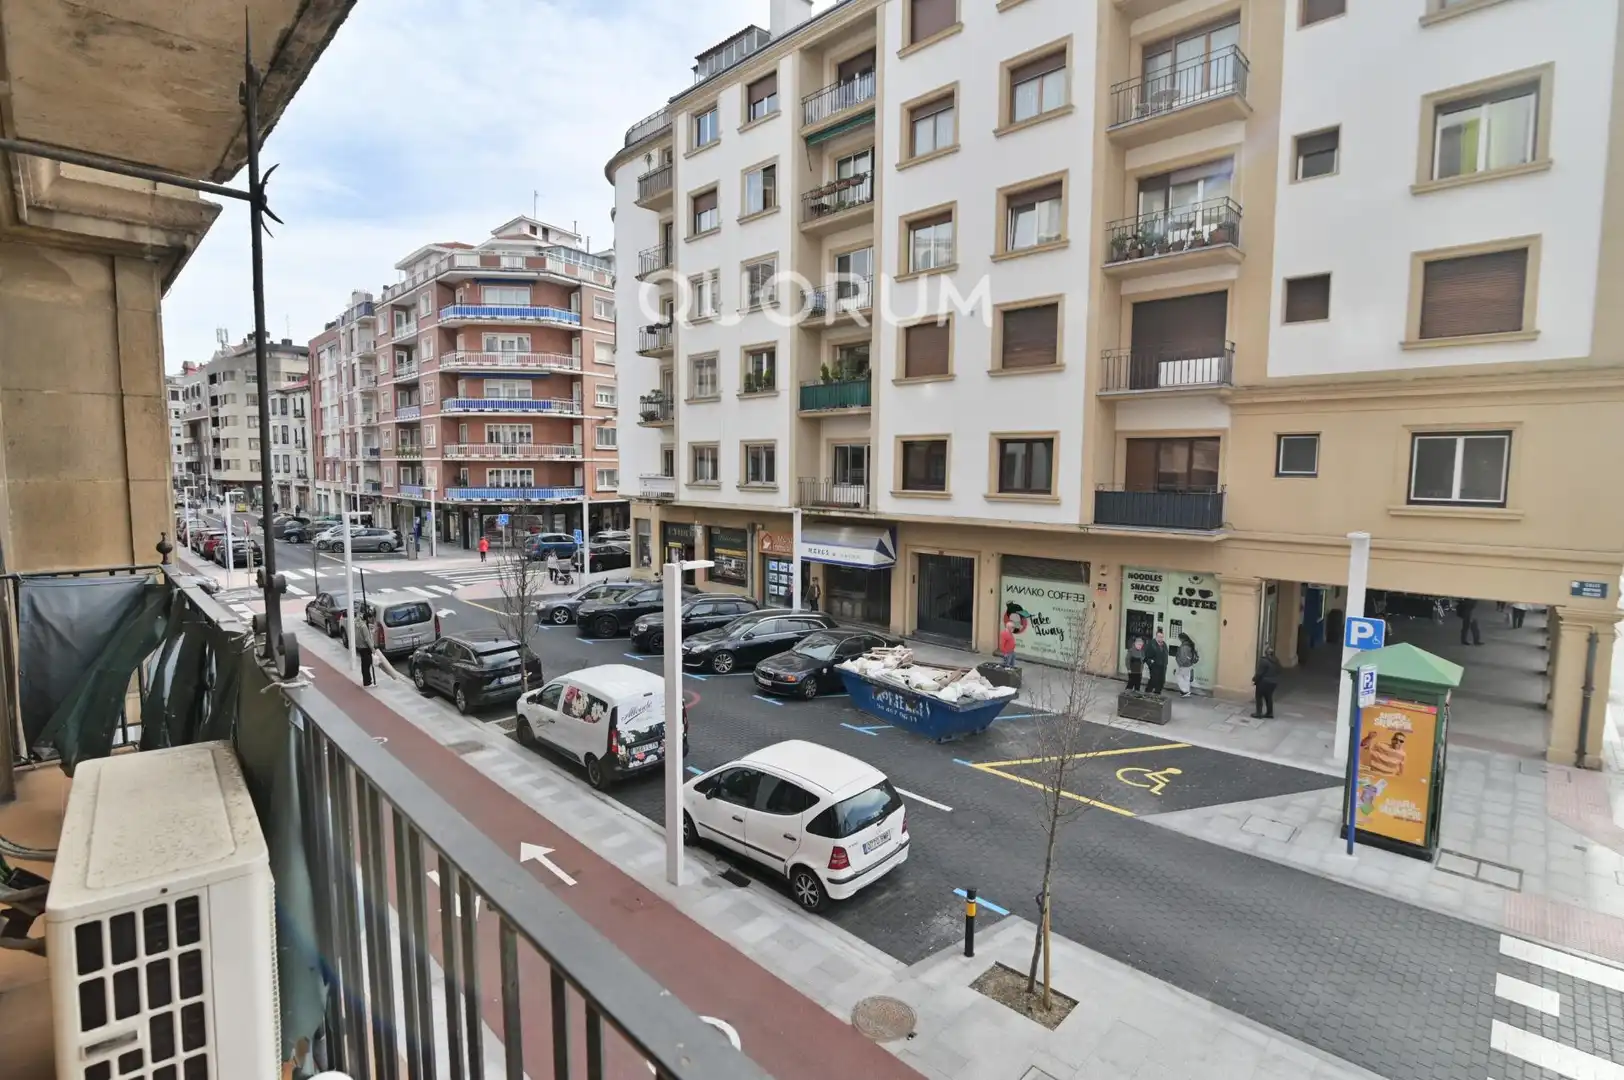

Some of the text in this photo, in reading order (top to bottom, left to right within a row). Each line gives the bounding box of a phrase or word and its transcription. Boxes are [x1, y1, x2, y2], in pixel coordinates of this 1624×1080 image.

[1127, 572, 1163, 582] NOODLES
[1130, 583, 1160, 593] SNACKS
[1178, 586, 1184, 595] I
[1133, 594, 1155, 603] FOOD
[1172, 596, 1217, 611] COFFEE
[1030, 612, 1051, 628] Take
[1034, 625, 1065, 641] Away
[1350, 620, 1374, 645] P
[1363, 673, 1371, 688] P
